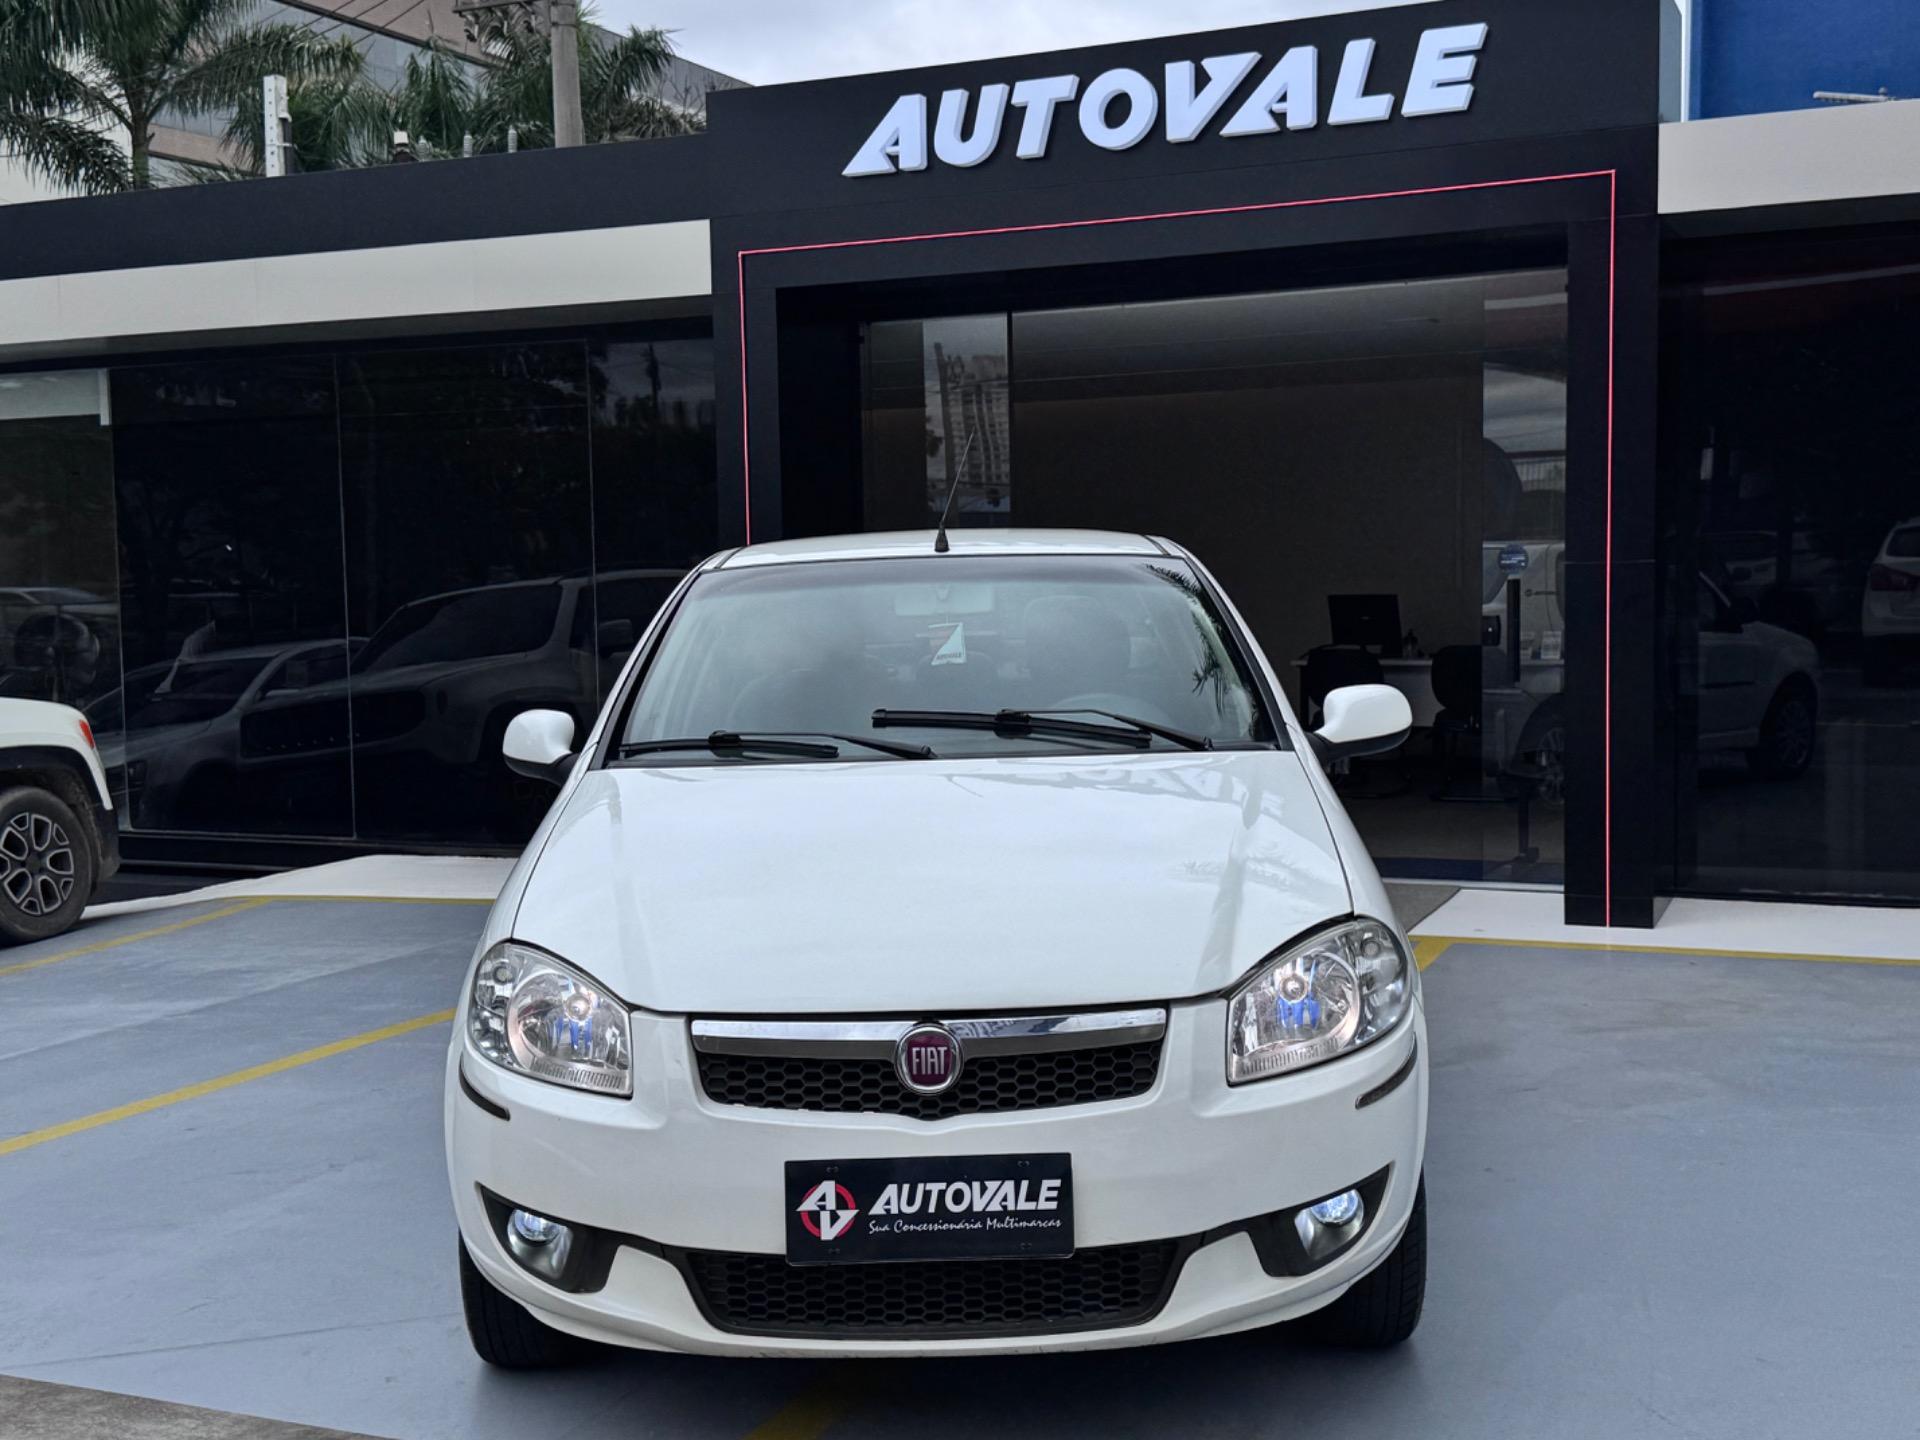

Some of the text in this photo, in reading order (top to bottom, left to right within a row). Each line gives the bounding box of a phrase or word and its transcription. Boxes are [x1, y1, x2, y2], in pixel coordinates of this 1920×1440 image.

[842, 22, 1488, 178] AUTOVALE
[911, 1046, 948, 1075] FIAT
[868, 1178, 1062, 1216] AUTOVALE
[869, 1215, 1062, 1235] Sua Concessionária Multimarcas
